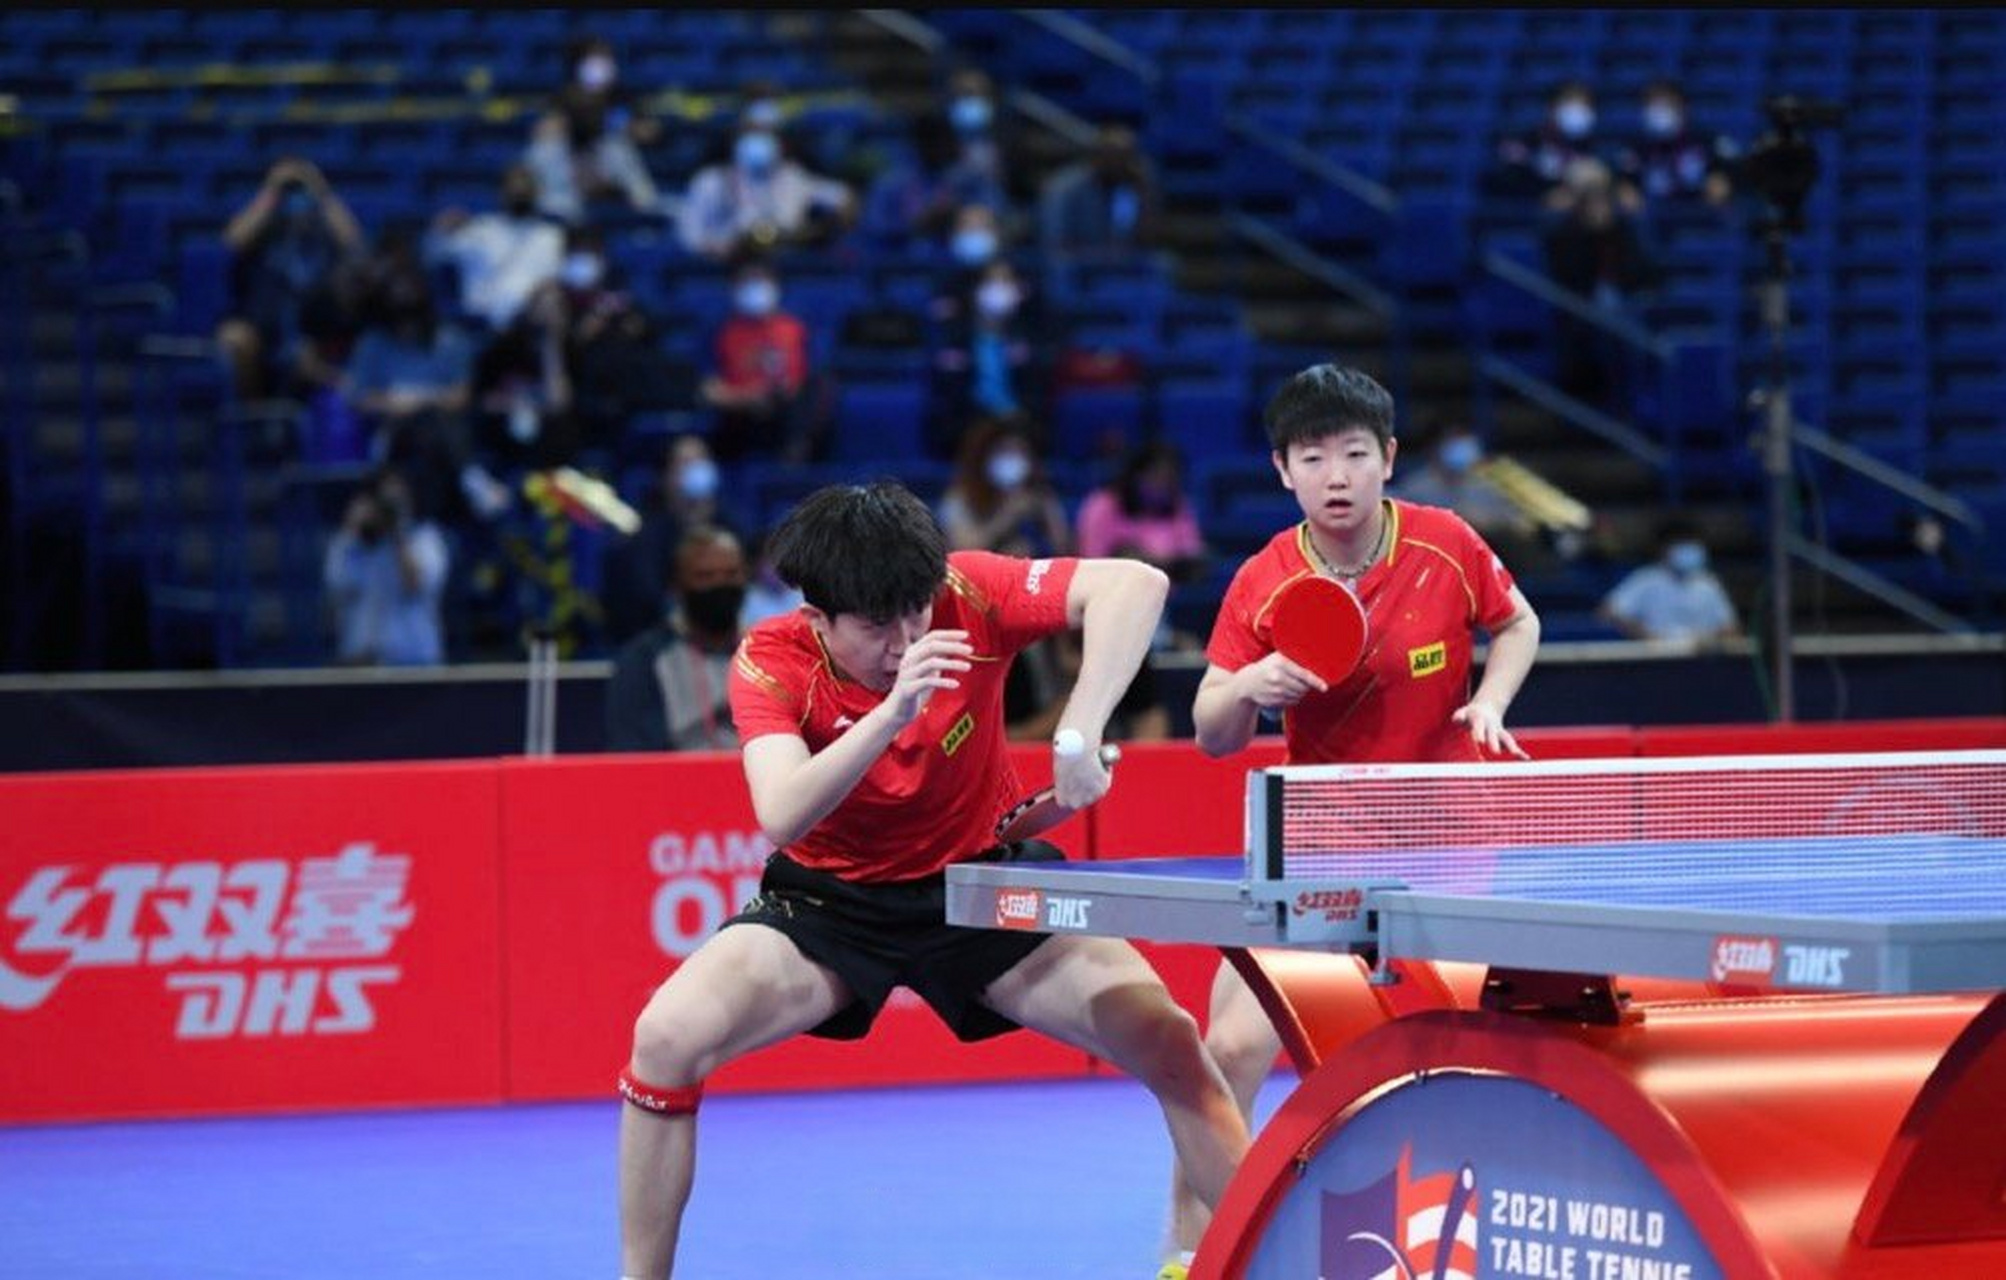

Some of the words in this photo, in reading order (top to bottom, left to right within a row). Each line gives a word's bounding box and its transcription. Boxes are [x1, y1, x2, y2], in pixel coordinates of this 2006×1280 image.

[0, 844, 415, 1011] 红双喜
[1784, 945, 1849, 985] DHS
[166, 967, 399, 1038] DHS
[1491, 1189, 1558, 1232] 2021
[1567, 1201, 1664, 1248] WORLD
[1491, 1236, 1577, 1280] TABLE
